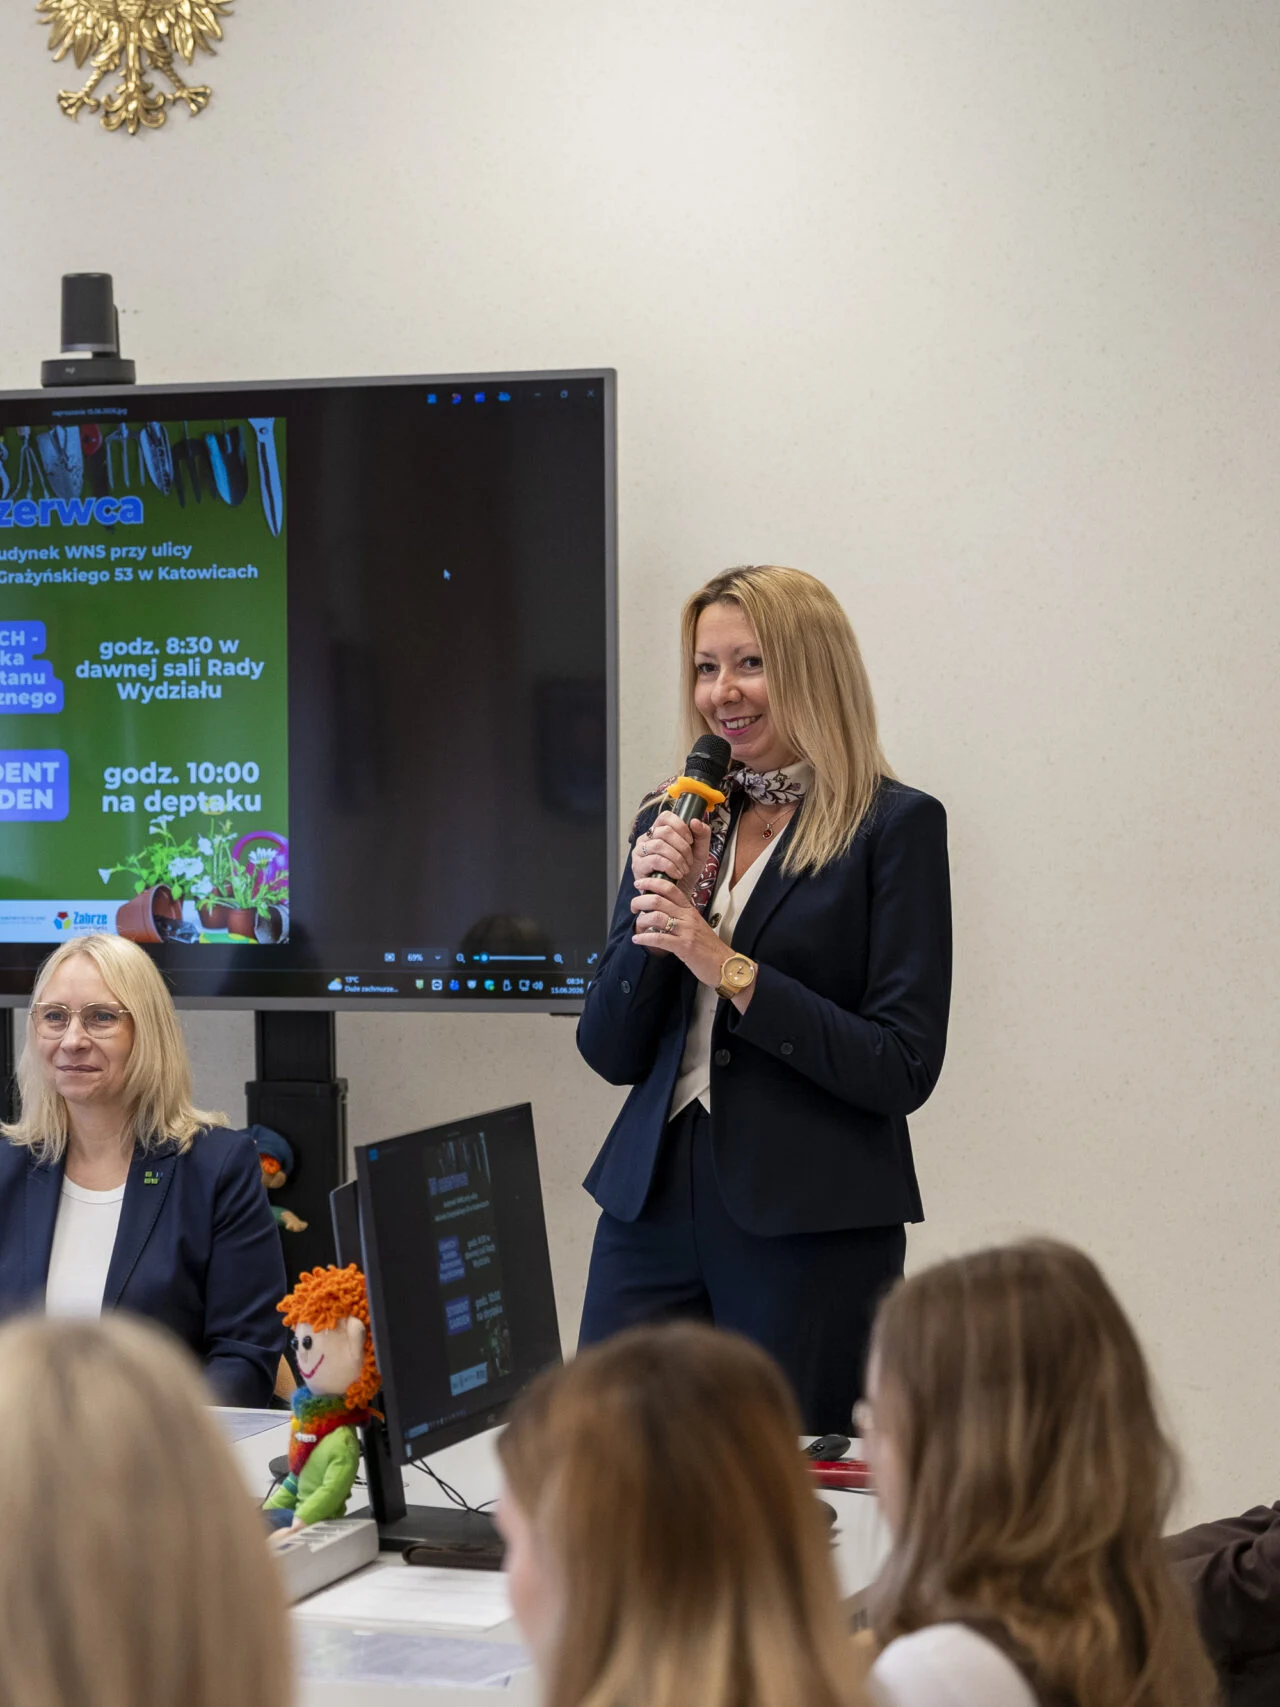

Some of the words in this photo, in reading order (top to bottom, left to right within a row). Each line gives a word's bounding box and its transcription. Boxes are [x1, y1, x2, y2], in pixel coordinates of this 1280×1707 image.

[64, 544, 106, 560] WNS
[110, 546, 147, 562] przy
[152, 542, 192, 559] ulicy
[114, 566, 133, 582] 53
[138, 569, 154, 580] w
[158, 564, 258, 581] Katowicach
[99, 637, 160, 659] godz.
[166, 636, 213, 655] 8:30
[218, 638, 239, 654] w
[75, 661, 157, 681] dawnej
[163, 658, 201, 677] sali
[207, 658, 265, 678] Rady
[117, 680, 222, 704] Wydziału
[103, 763, 180, 789] godz.
[186, 761, 260, 785] 10:00
[102, 797, 136, 812] na
[144, 789, 262, 817] deptaku
[73, 911, 108, 925] Zabrze
